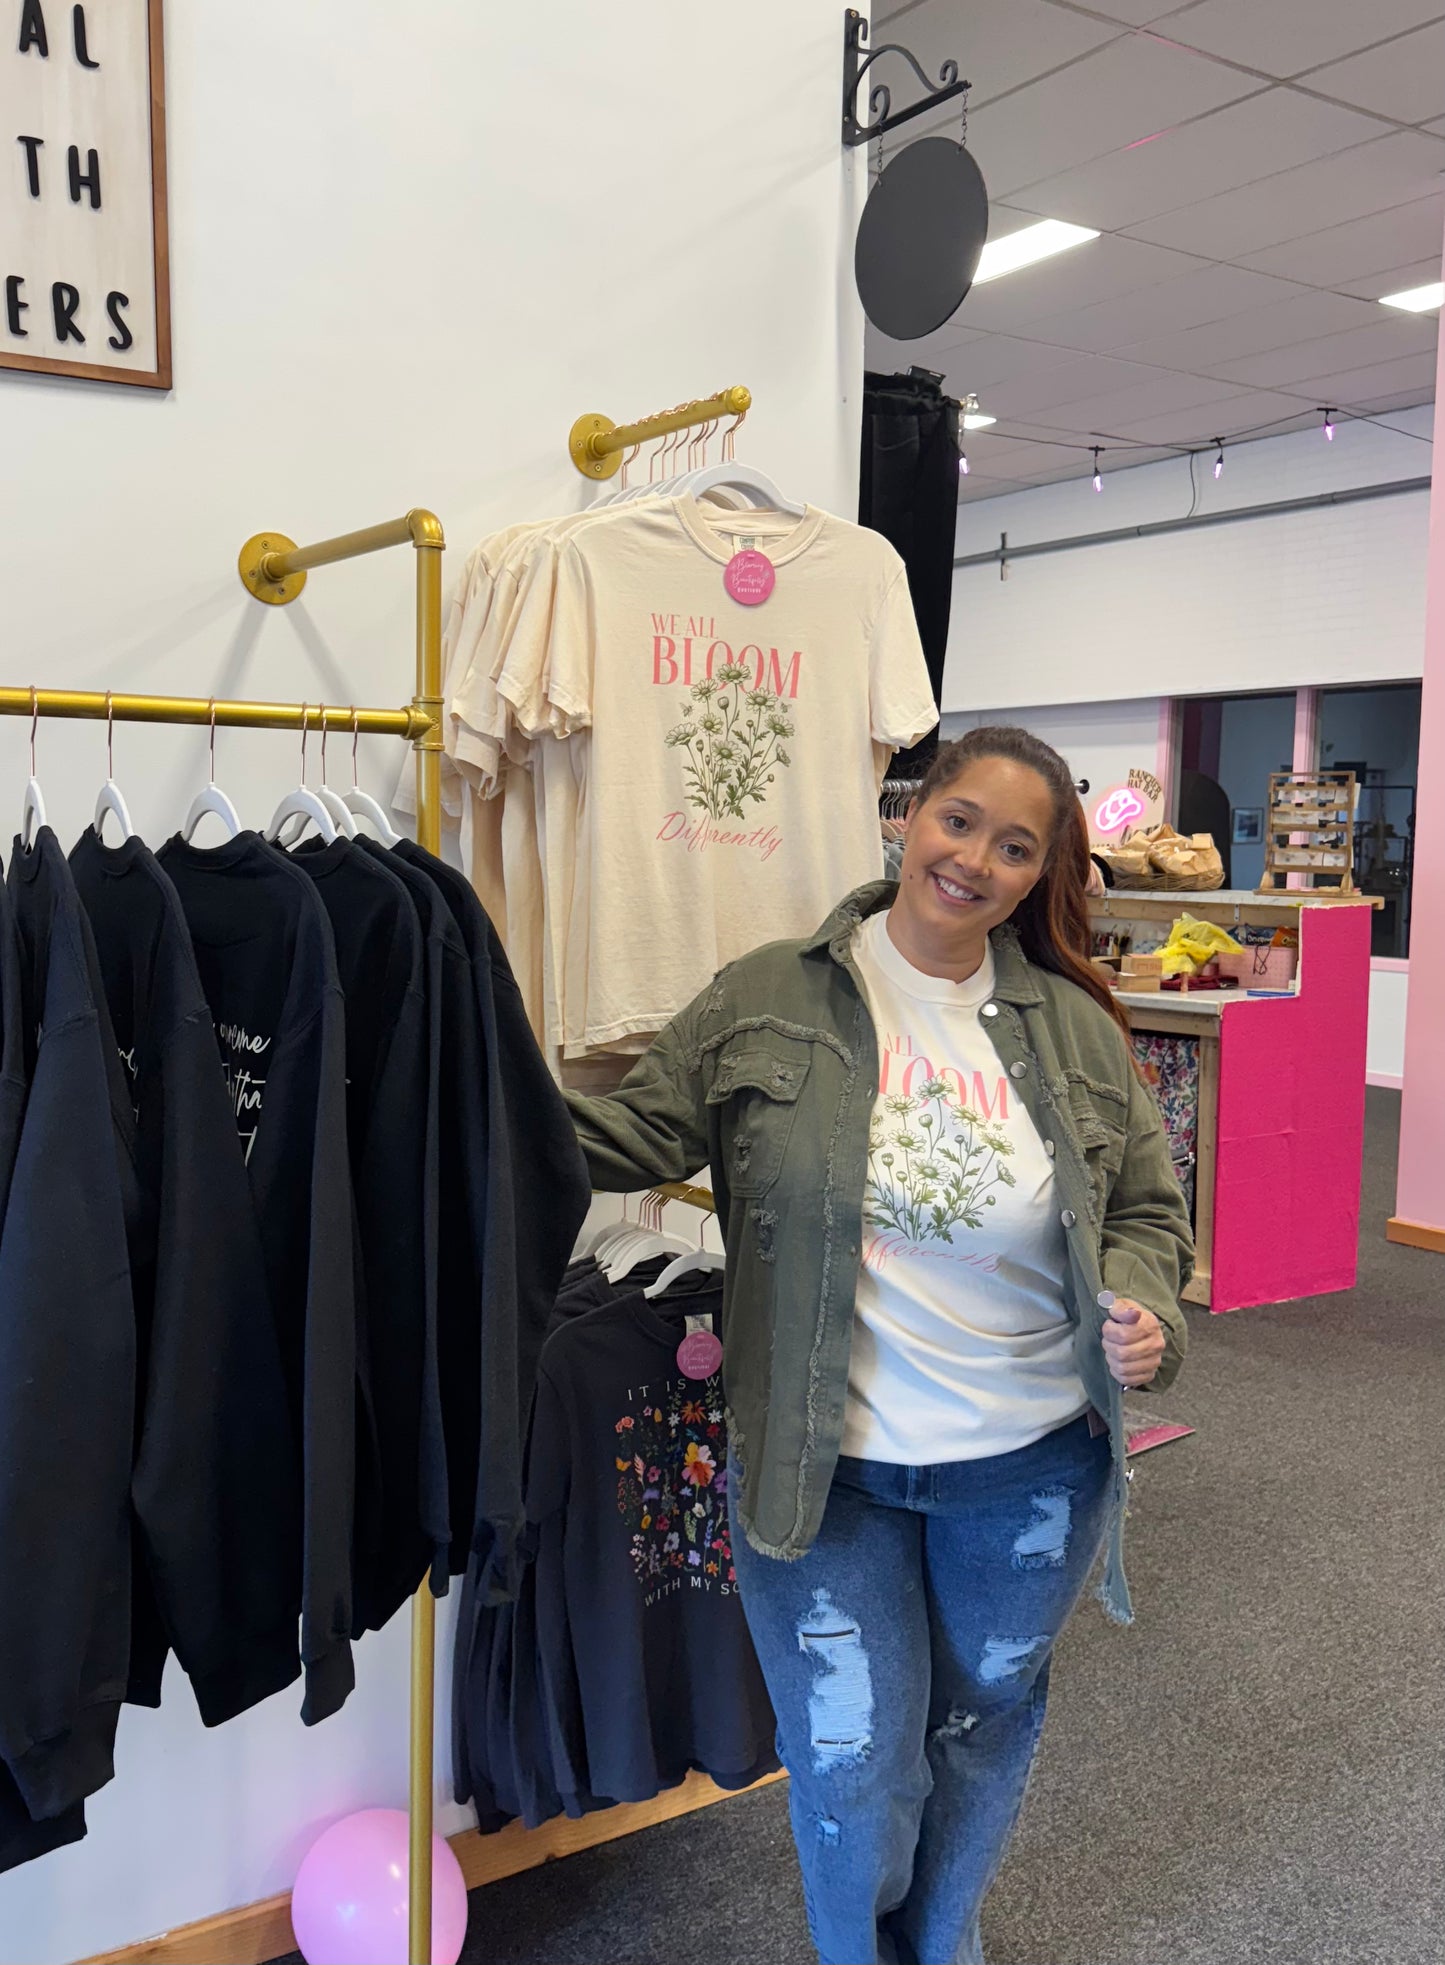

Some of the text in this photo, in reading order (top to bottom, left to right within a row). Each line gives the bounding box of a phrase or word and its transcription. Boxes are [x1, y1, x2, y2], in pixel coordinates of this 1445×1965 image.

[6, 275, 133, 350] ERS
[651, 612, 719, 640] WE ALL
[652, 635, 802, 699] BLOOM
[656, 811, 783, 862] Diffrently
[882, 1031, 918, 1057] ALL
[878, 1048, 1010, 1121] LOOM
[628, 1378, 686, 1401] IT IS
[645, 1576, 740, 1606] WITH MY SO
